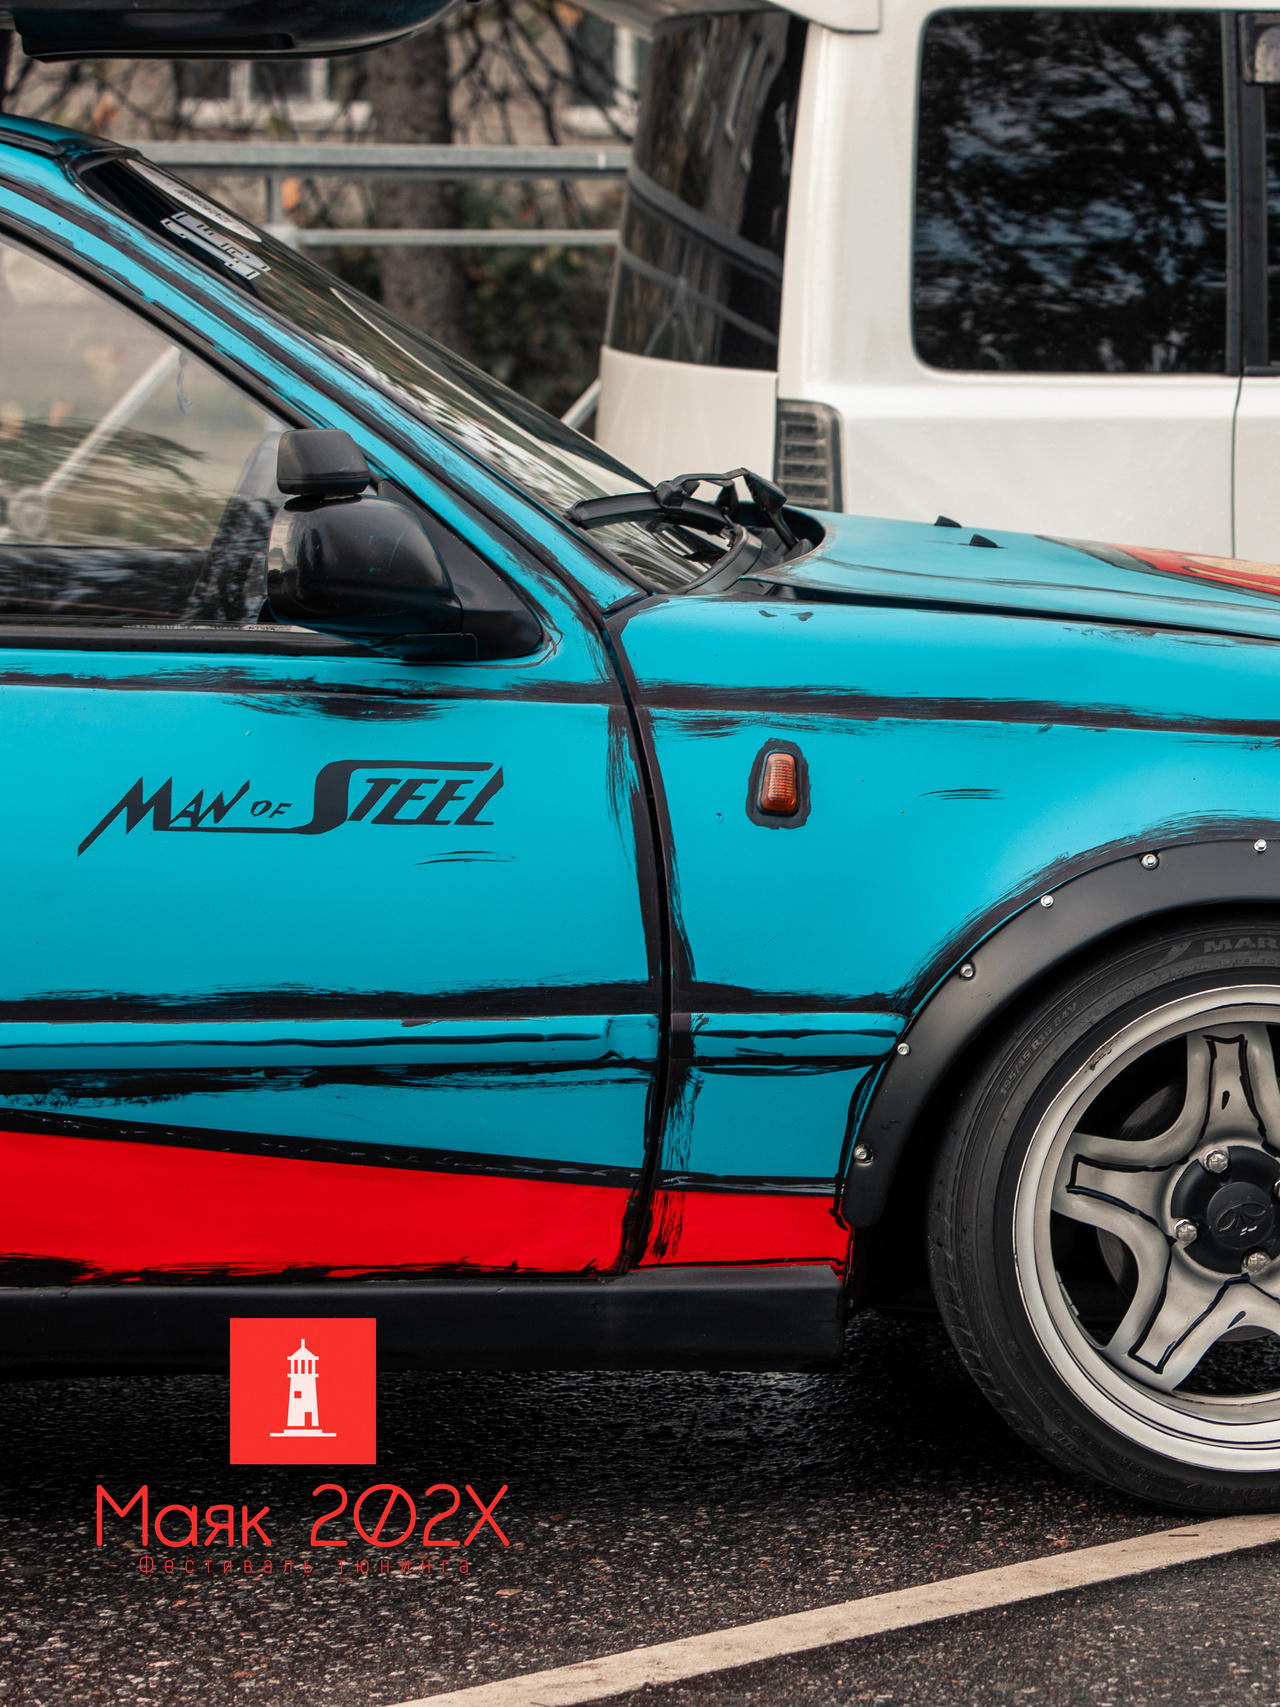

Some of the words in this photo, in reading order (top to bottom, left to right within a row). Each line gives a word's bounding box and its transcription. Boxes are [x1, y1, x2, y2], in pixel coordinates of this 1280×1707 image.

[1000, 1051, 1031, 1095] 195/45
[1031, 1026, 1053, 1051] R16
[1054, 1002, 1078, 1027] 84V
